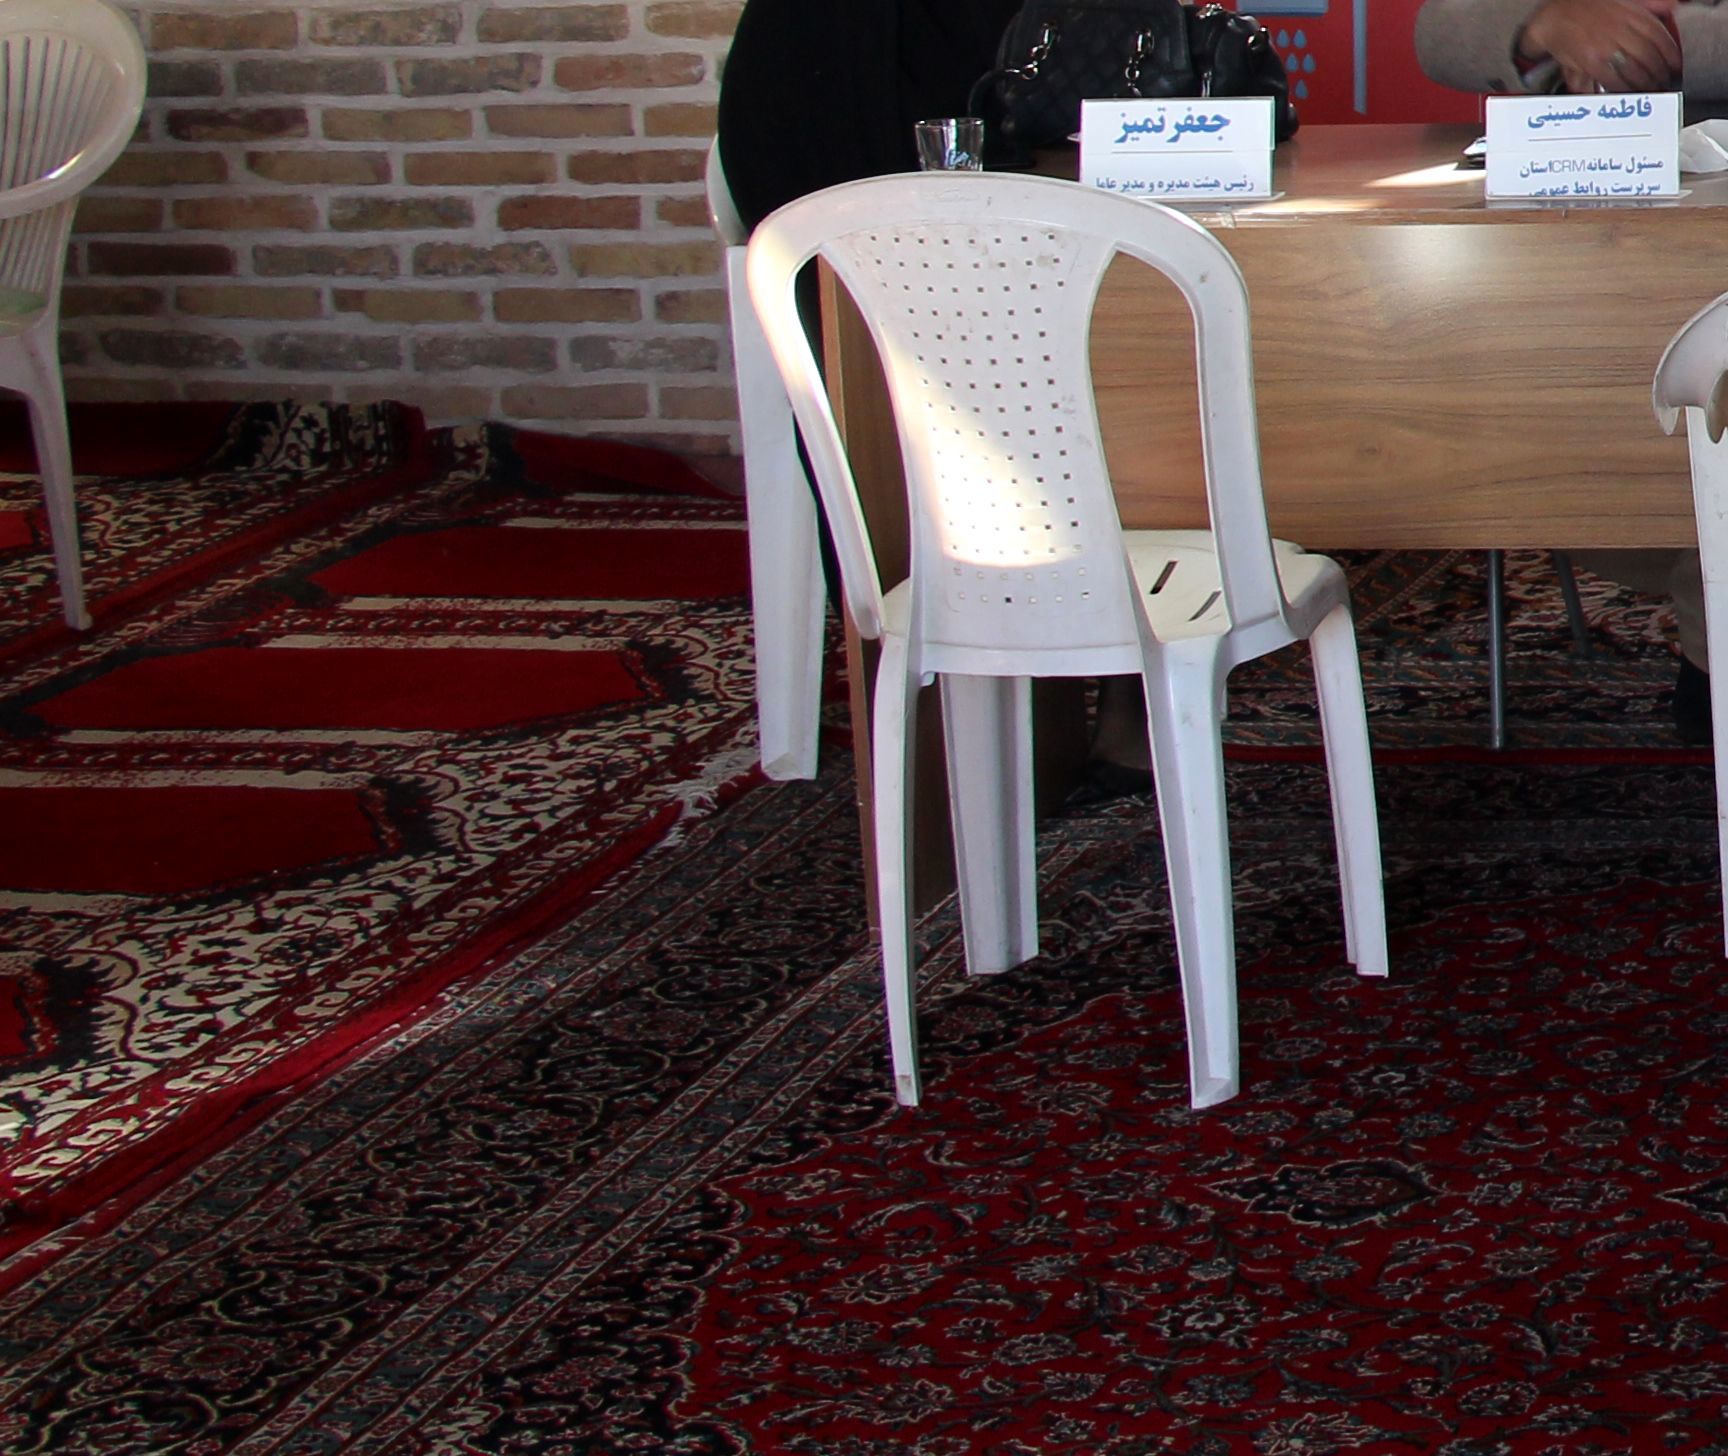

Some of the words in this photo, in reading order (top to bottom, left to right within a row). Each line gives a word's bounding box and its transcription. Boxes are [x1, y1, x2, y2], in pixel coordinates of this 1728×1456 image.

[1527, 103, 1591, 129] حسینی
[1597, 95, 1653, 120] فاطمه
[1113, 106, 1167, 144] تمیز
[1166, 106, 1231, 144] جعفر
[1518, 159, 1552, 178] استان
[1551, 159, 1586, 173] CRM
[1586, 157, 1623, 172] سامانه
[1624, 156, 1664, 175] مسئول
[1121, 177, 1145, 193] مدیر
[1157, 178, 1191, 193] مدیره
[1193, 176, 1221, 192] هیئت
[1223, 175, 1254, 192] رئیس
[1572, 180, 1609, 196] روابط
